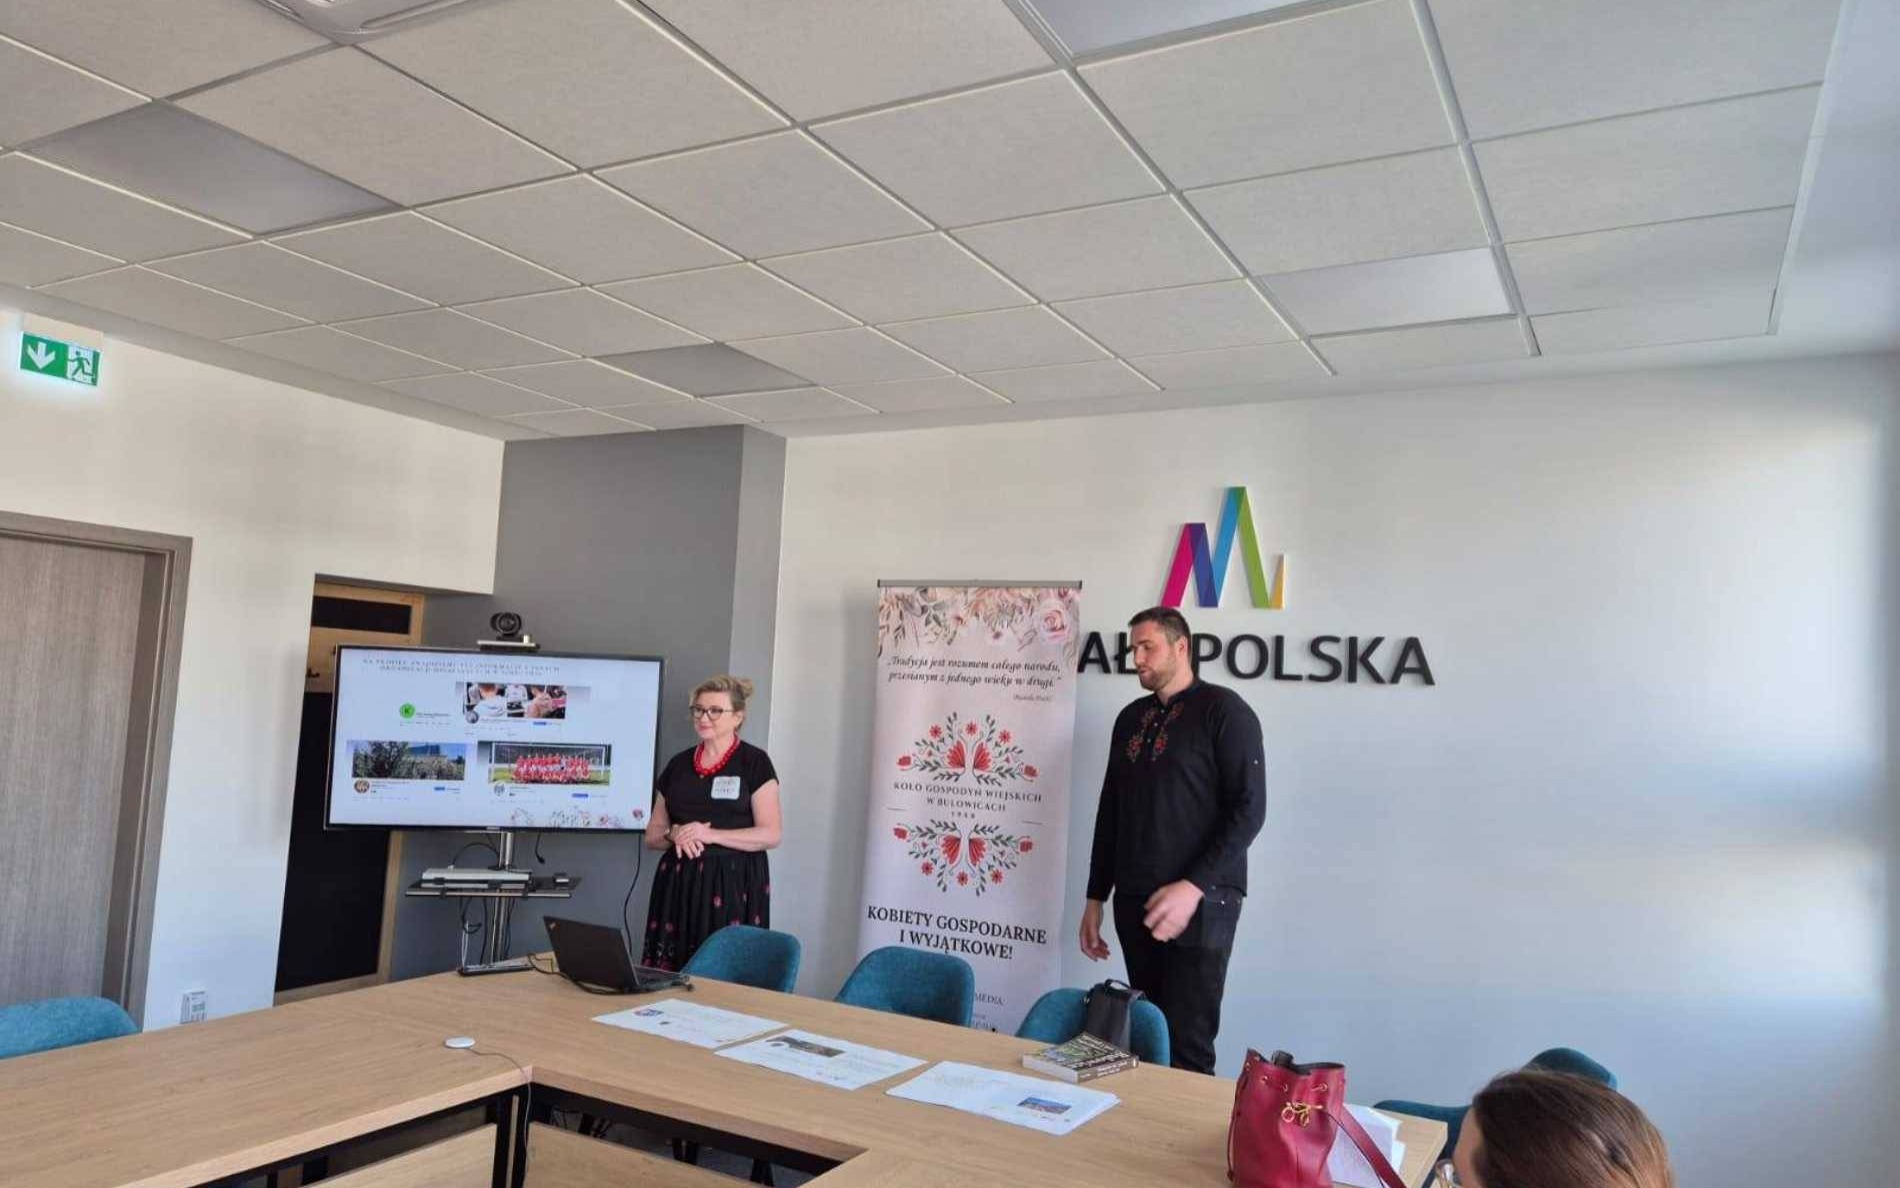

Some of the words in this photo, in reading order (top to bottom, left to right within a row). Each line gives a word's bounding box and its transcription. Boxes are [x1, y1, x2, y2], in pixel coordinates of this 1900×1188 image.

[929, 657, 946, 669] jest
[1077, 630, 1436, 686] AŁPOLSKA
[926, 796, 935, 804] W
[985, 789, 1043, 803] WIEJSKICH
[867, 905, 933, 926] KOBIETY
[936, 915, 1047, 945] GOSPODARNE
[899, 930, 906, 943] I
[908, 931, 1013, 960] WYJĄTKOWE!
